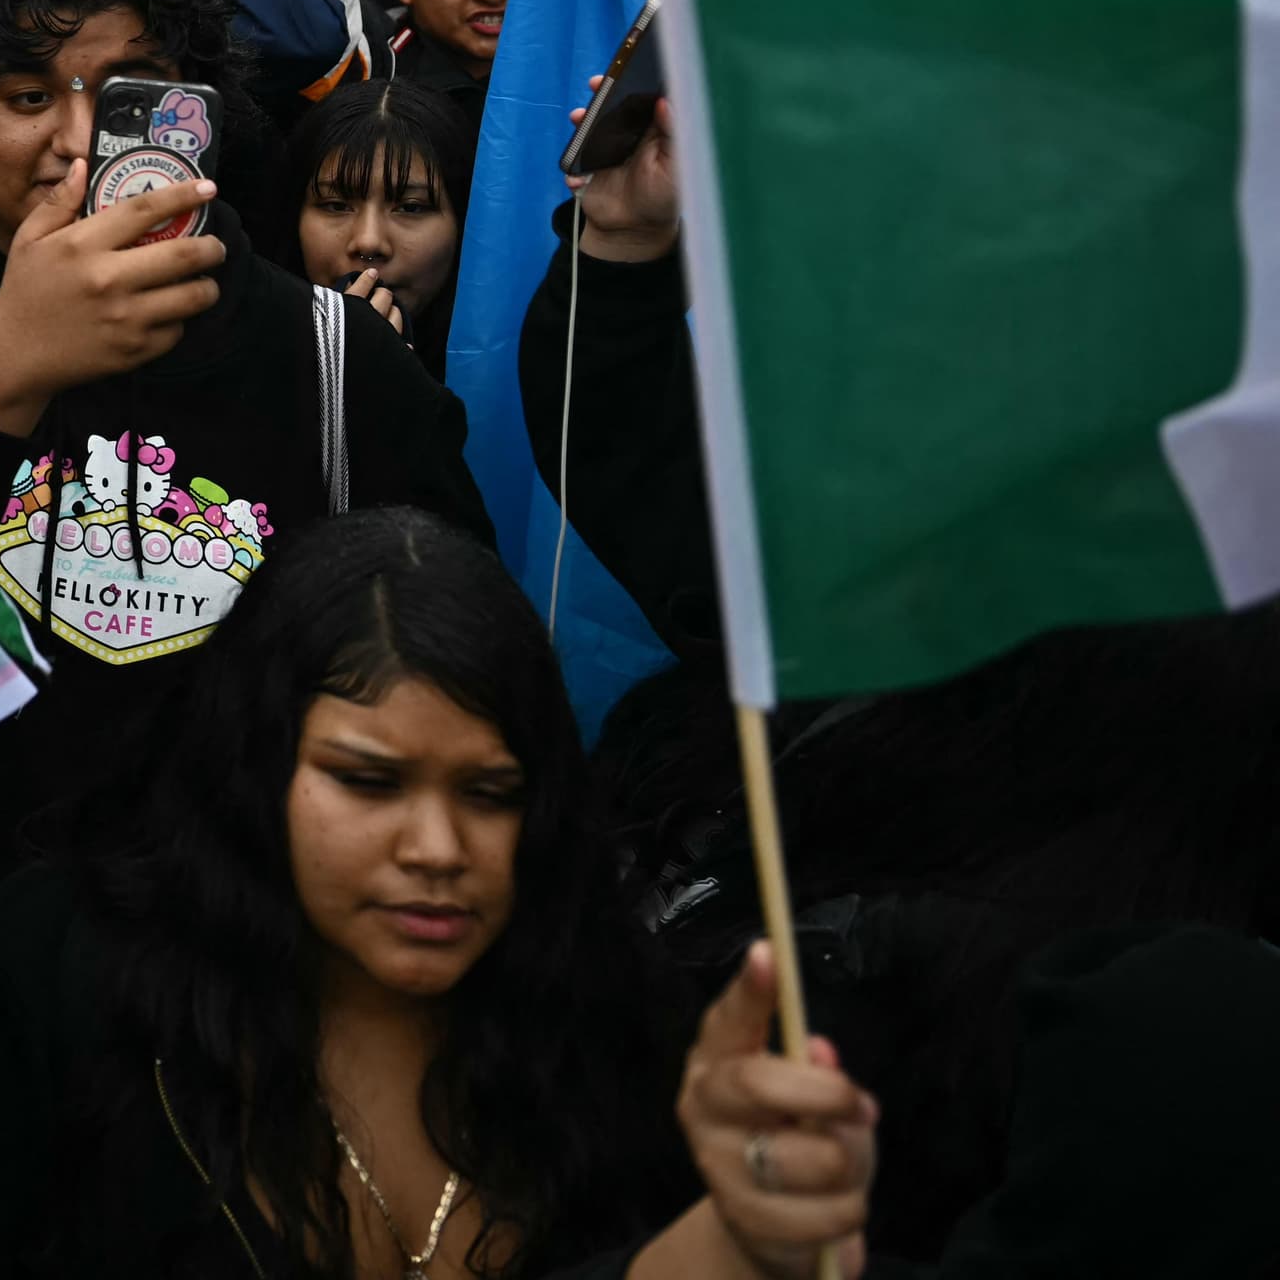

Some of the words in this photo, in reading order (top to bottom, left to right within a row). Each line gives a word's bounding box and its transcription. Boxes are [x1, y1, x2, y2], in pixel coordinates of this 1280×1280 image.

[130, 156, 178, 177] STARDUST
[31, 514, 227, 565] WELCOME
[55, 557, 72, 572] TO
[76, 557, 178, 586] Fabuous
[36, 577, 122, 608] ELLO
[126, 588, 203, 617] KITTY
[84, 610, 153, 637] CAFE
